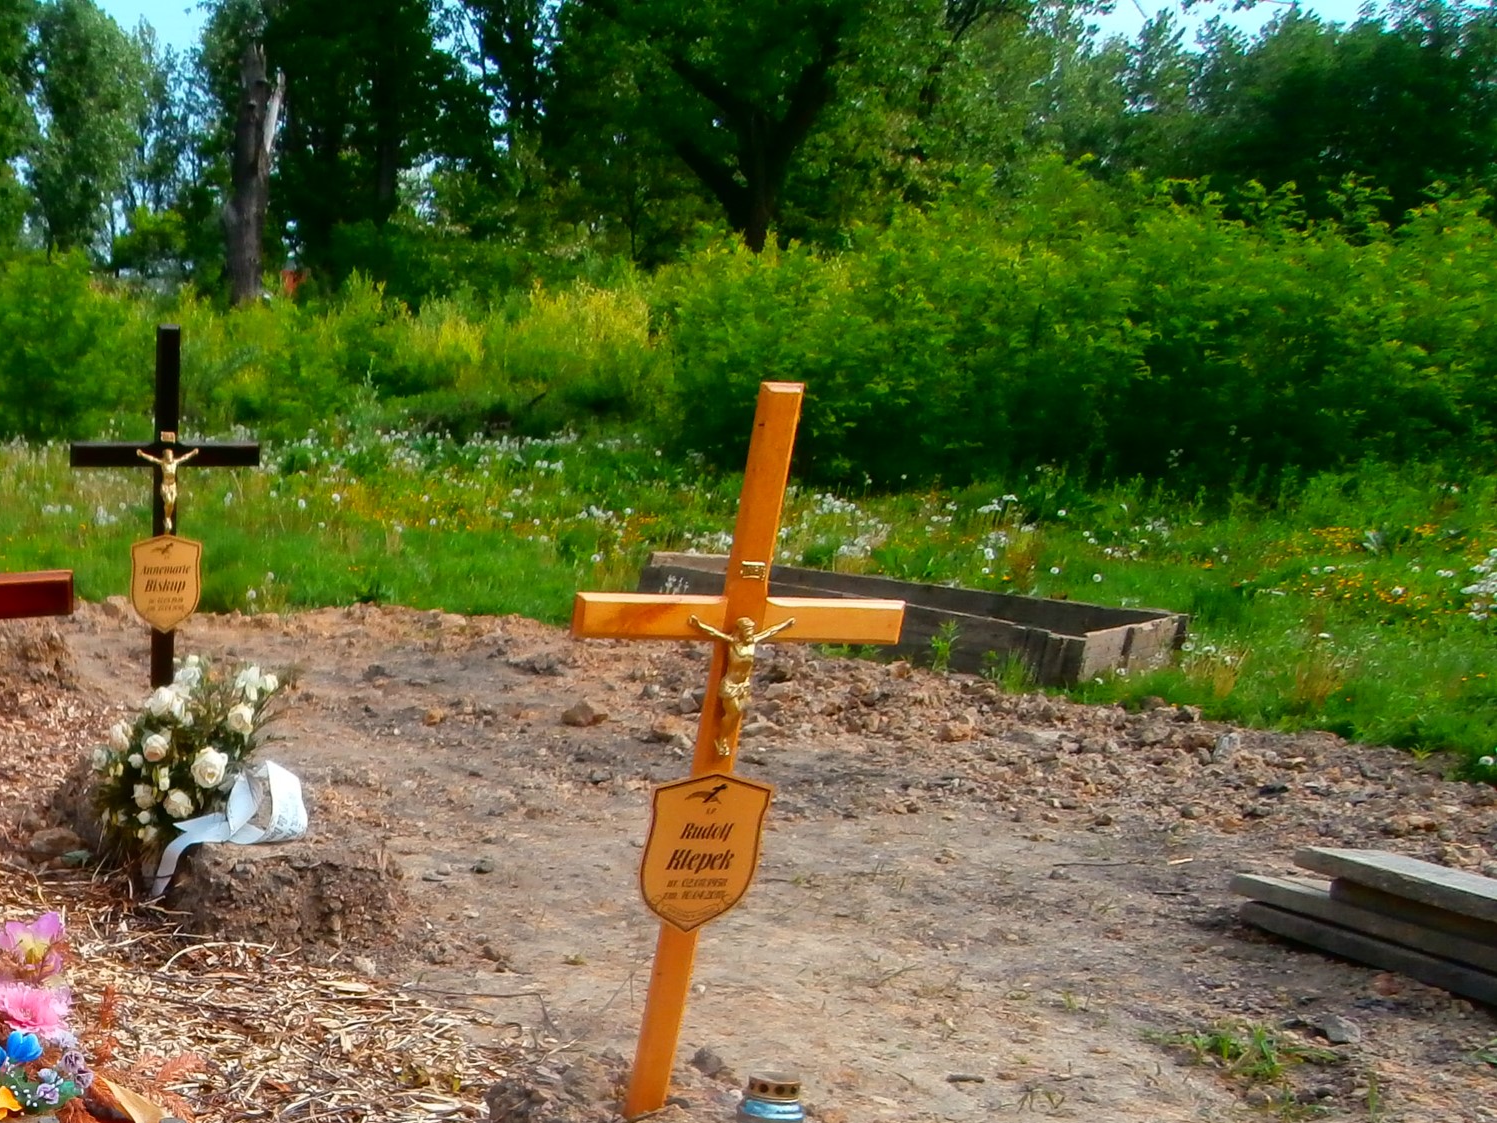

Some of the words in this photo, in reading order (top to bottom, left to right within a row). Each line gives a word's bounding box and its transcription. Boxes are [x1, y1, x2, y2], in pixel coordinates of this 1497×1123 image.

[140, 565, 191, 575] Annemarie
[145, 579, 186, 594] Biskup
[680, 823, 734, 842] Rudolf
[666, 849, 735, 874] Klepek
